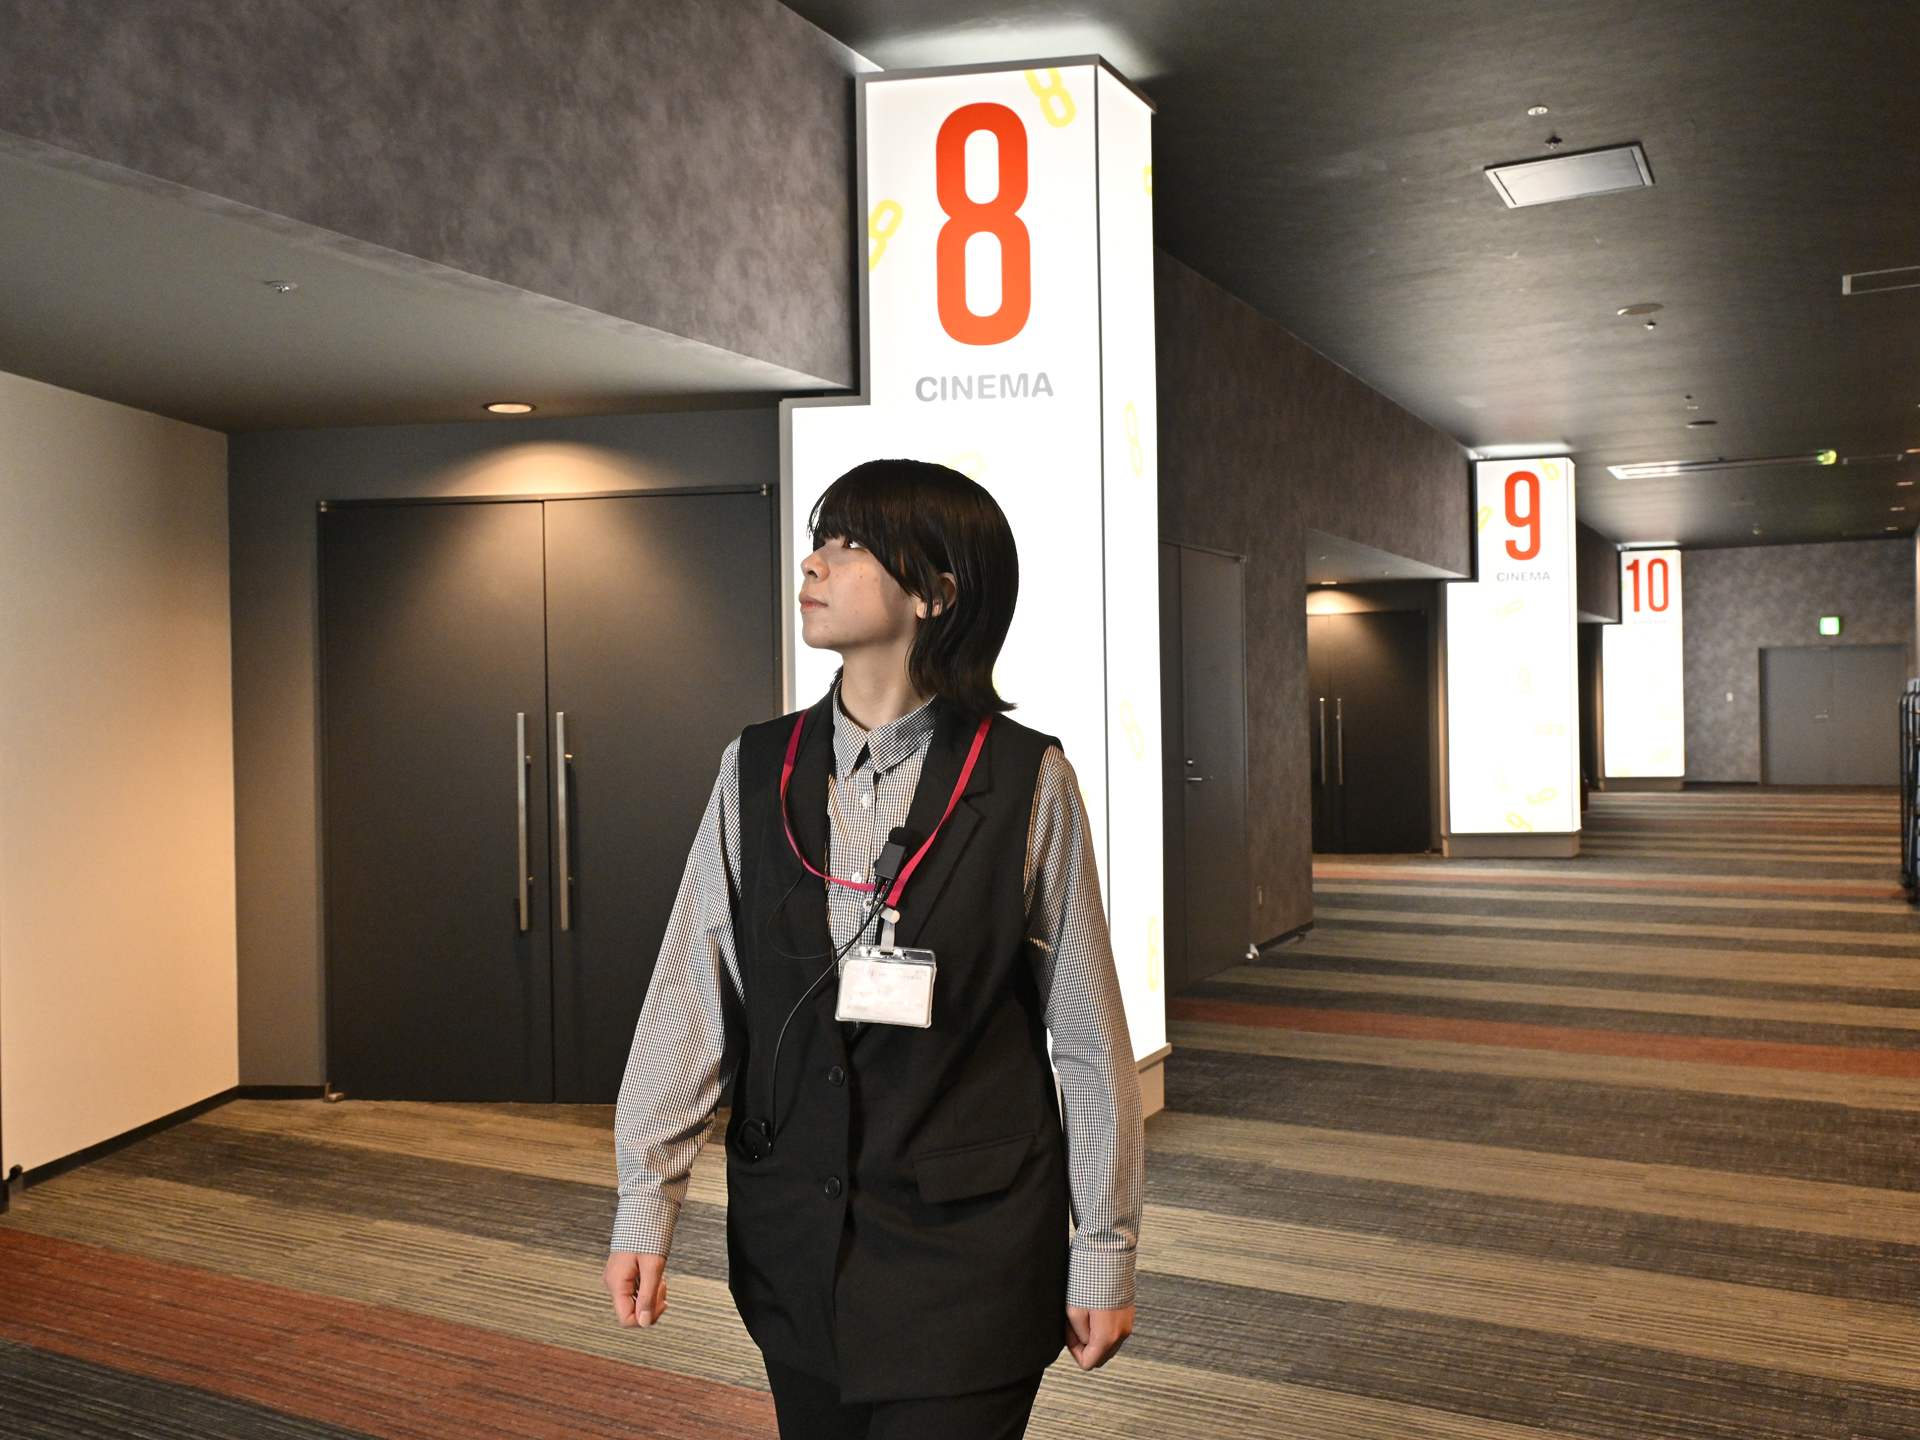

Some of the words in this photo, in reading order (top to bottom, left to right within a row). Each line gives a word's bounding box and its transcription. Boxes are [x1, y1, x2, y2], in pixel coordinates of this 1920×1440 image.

[936, 101, 1031, 346] 8
[914, 371, 1054, 402] CINEMA
[1504, 470, 1541, 561] 9
[1496, 572, 1551, 582] CINEMA
[1625, 557, 1670, 613] 10
